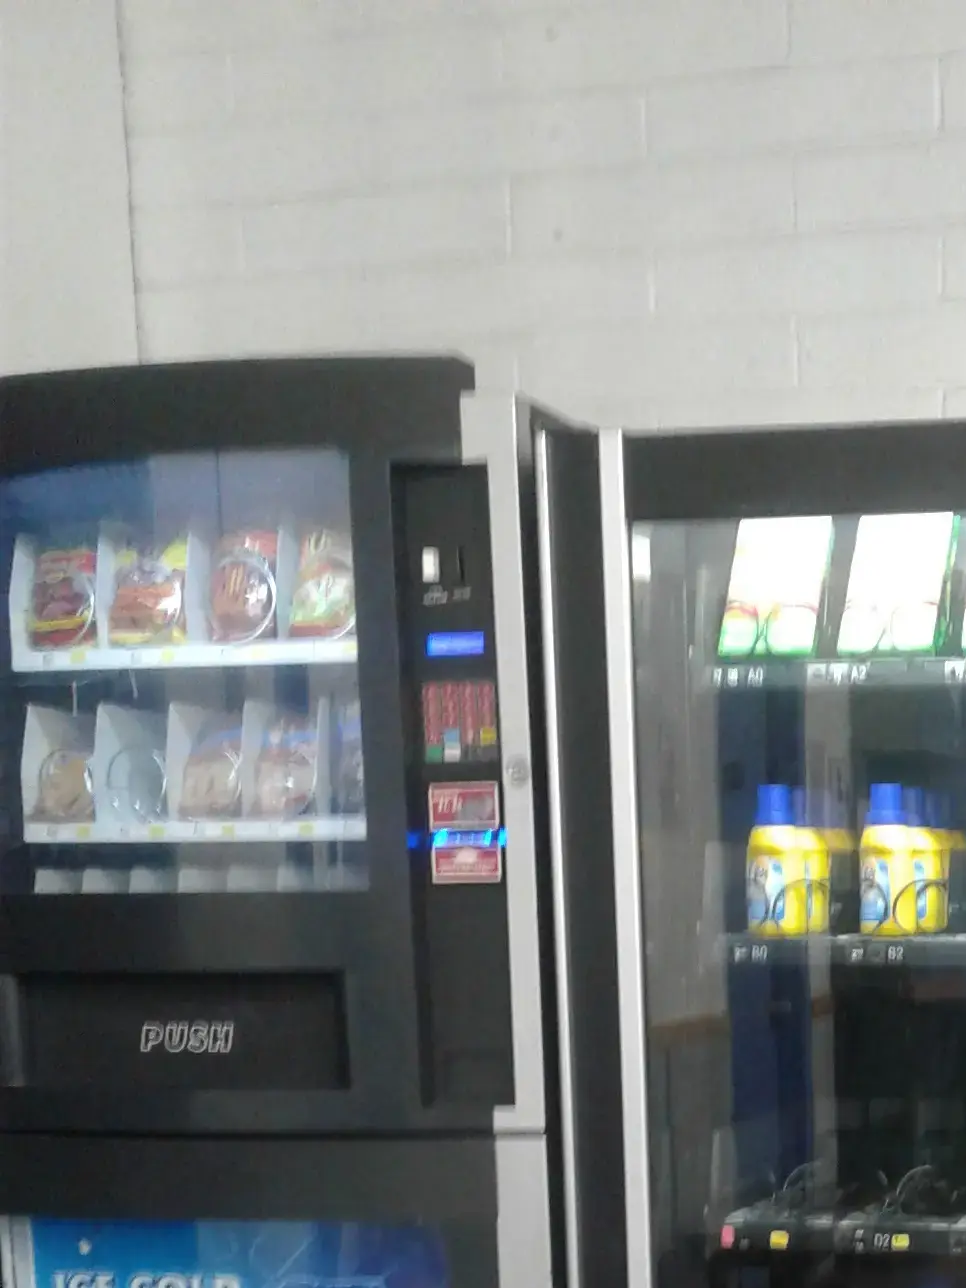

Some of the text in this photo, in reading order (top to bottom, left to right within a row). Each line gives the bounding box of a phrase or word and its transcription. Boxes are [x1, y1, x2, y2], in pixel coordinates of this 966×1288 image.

[851, 666, 867, 681] A2
[140, 1020, 235, 1053] PUSH
[873, 1233, 890, 1249] D2
